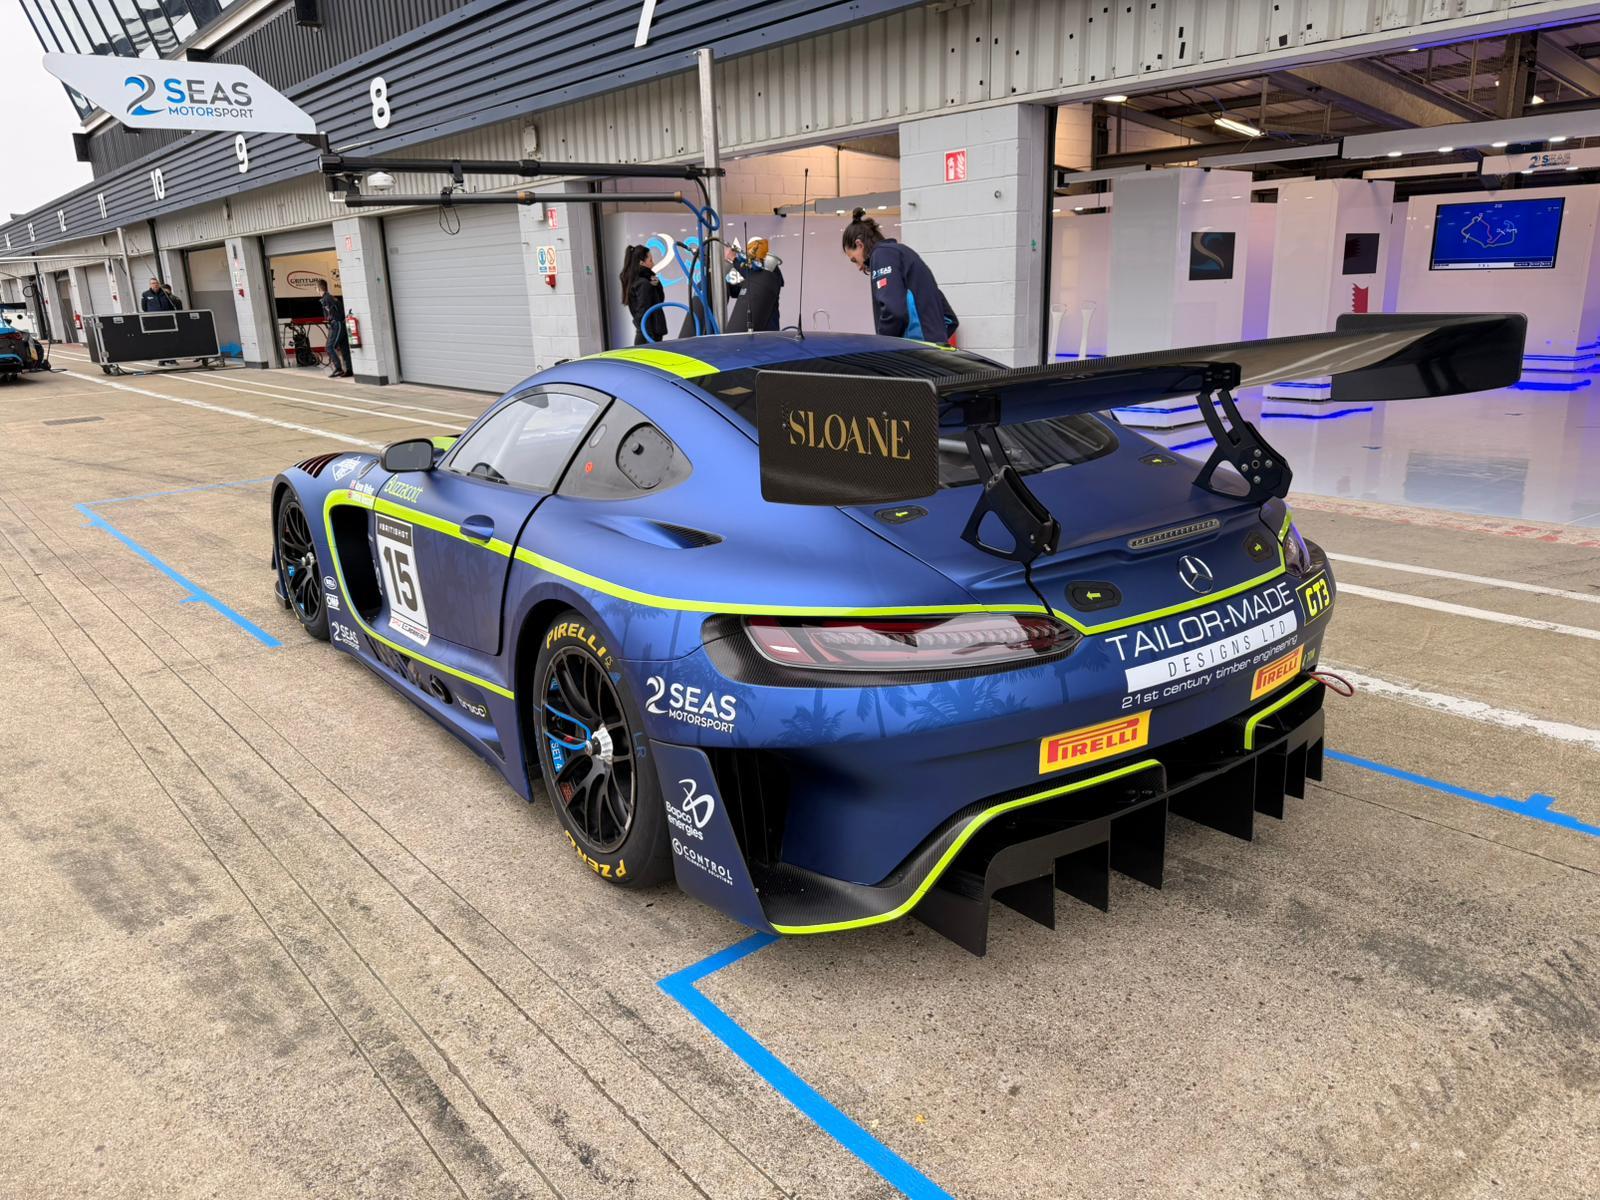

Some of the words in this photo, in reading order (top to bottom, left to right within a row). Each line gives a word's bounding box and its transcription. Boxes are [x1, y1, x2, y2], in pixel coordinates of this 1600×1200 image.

[124, 74, 167, 116] 2
[163, 78, 252, 107] SEAS
[168, 105, 253, 118] MOTORSPORT
[370, 77, 390, 129] 8
[235, 134, 249, 173] 9
[151, 168, 165, 200] 10
[97, 193, 107, 219] 11
[789, 409, 911, 460] SLOANE
[384, 546, 418, 612] 15
[1305, 578, 1330, 617] GT3
[340, 625, 359, 644] SEAS
[546, 622, 607, 657] PIRELLI
[1105, 582, 1294, 661] TAILOR-MADE
[1168, 635, 1252, 678] DESIGNS
[1262, 620, 1286, 643] LTD
[1256, 647, 1300, 690] PIRELLI
[1121, 689, 1159, 709] 21st
[1163, 672, 1213, 699] century
[1215, 659, 1252, 682] timber
[1252, 635, 1298, 665] engineering
[646, 676, 668, 714] 2
[669, 682, 737, 722] SEAS
[669, 710, 735, 733] MOTORSPORT
[1047, 717, 1140, 765] PIRELLI
[551, 743, 562, 765] SET
[665, 801, 692, 824] Bapco
[667, 815, 703, 840] energies
[615, 859, 627, 878] P
[683, 846, 733, 880] CONTROL
